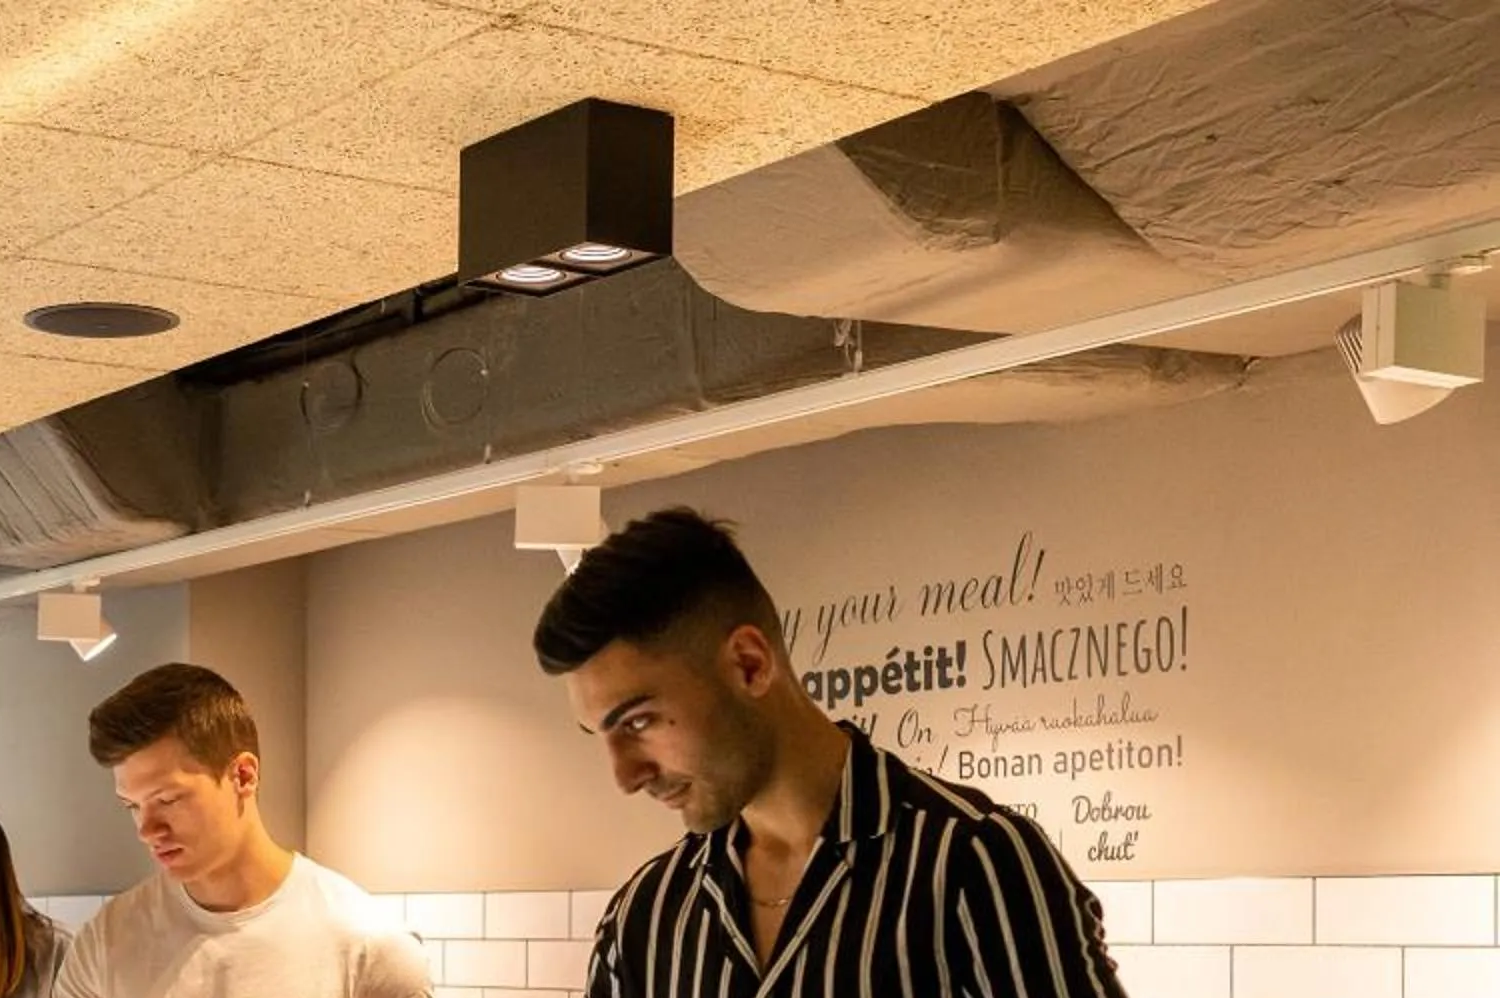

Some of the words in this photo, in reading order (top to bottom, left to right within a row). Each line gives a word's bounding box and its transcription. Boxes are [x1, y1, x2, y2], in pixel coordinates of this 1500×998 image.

[812, 585, 901, 666] your
[921, 530, 1045, 616] meal!
[1054, 570, 1116, 605] 맛있게
[1122, 563, 1188, 596] 드세요
[802, 640, 967, 707] appétit!
[982, 605, 1188, 690] SMACZNEGO!
[897, 706, 934, 748] On
[1041, 691, 1160, 733] ruokahalua
[959, 751, 1042, 779] Bonan
[1053, 735, 1184, 780] apetiton!
[1072, 791, 1152, 824] Dobrou
